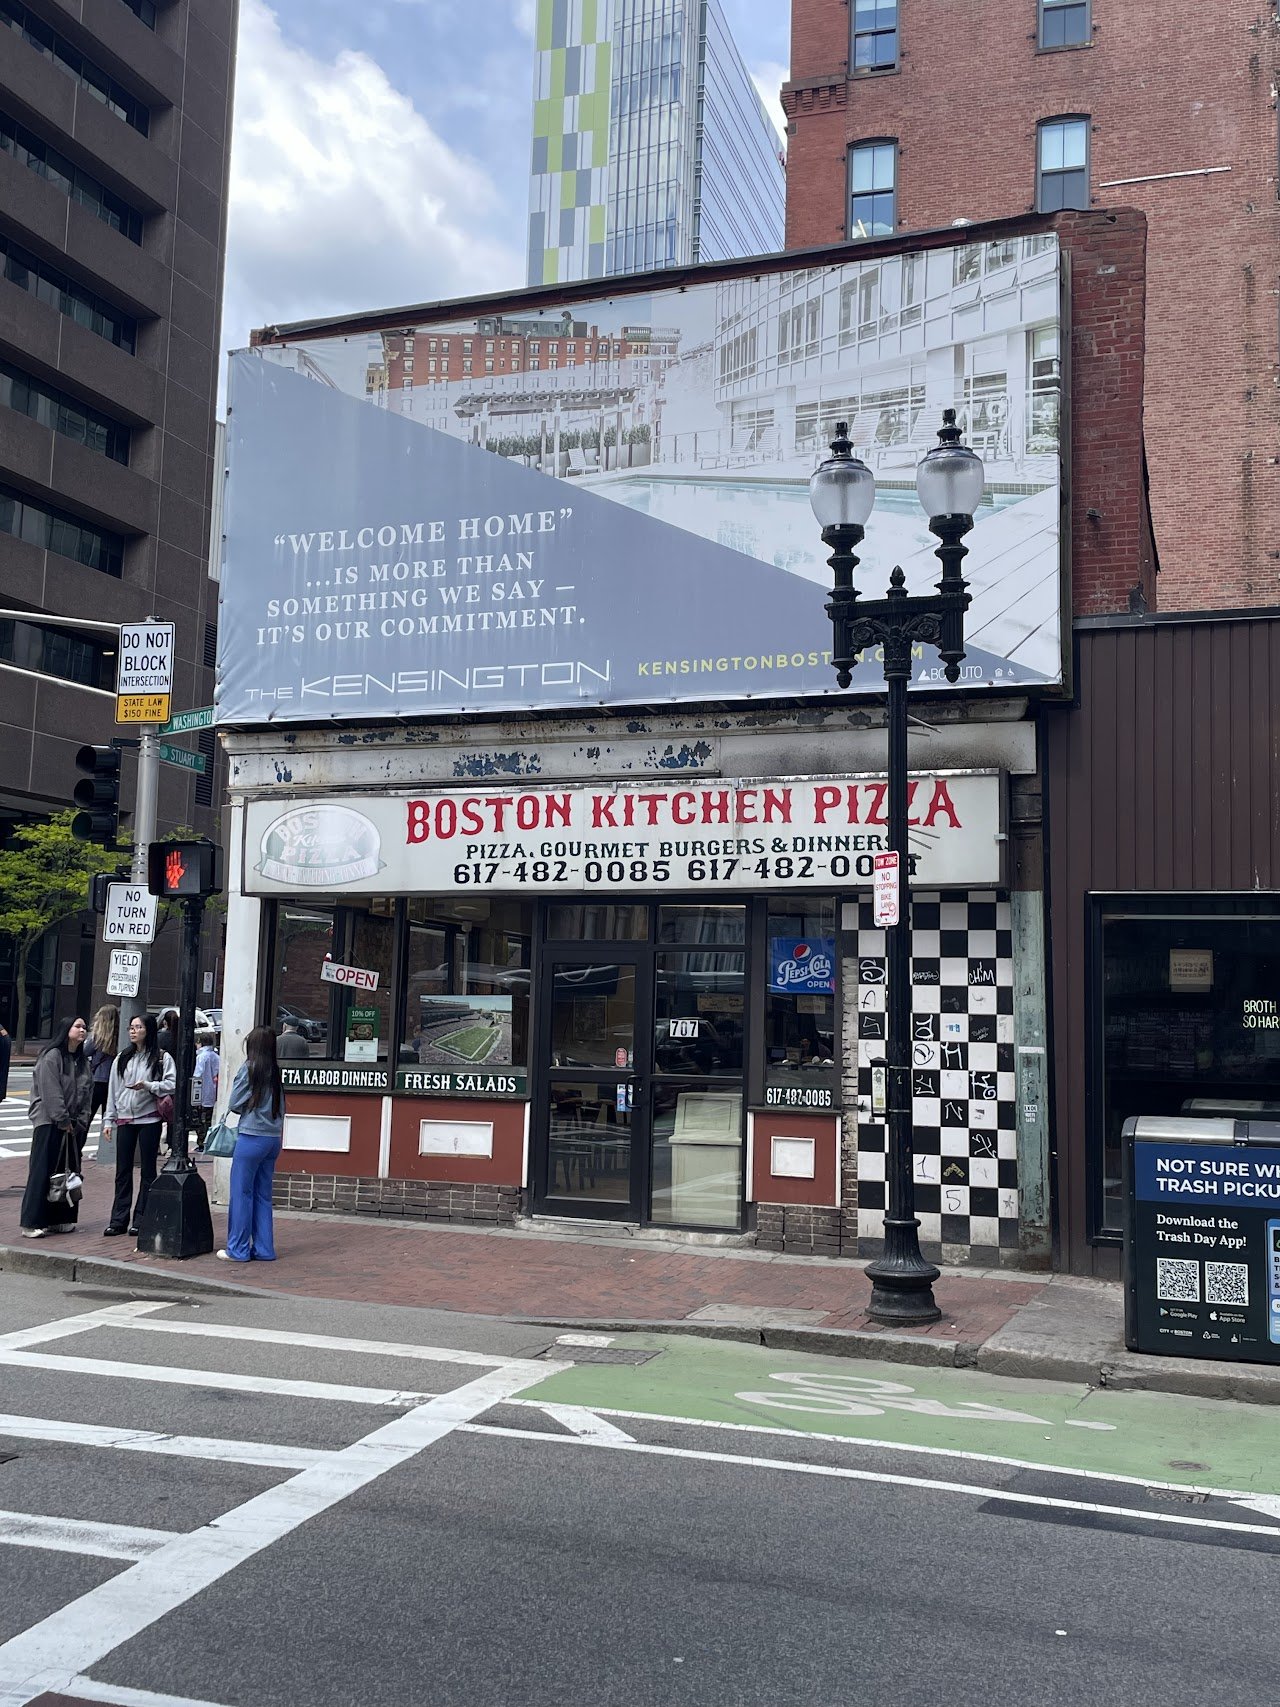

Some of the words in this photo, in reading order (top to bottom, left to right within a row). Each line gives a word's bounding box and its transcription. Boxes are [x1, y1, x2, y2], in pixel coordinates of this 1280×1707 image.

[369, 559, 447, 582] MORE
[457, 551, 534, 575] THAN
[267, 591, 428, 617] SOMETHING
[438, 584, 480, 604] WE
[491, 579, 545, 601] SAY
[256, 623, 306, 646] IT’S
[315, 618, 371, 641] OUR
[380, 605, 586, 638] COMMITMENT.
[122, 633, 140, 648] DO
[146, 632, 171, 648] NOT
[125, 655, 167, 671] BLOCK
[638, 645, 924, 677] KENSINGTONBOSTN.CM
[121, 675, 169, 687] INTERSECTION
[245, 686, 293, 700] THE
[301, 659, 610, 697] KENSINGTON
[931, 665, 983, 681] BOUTO
[124, 698, 144, 707] STATE
[148, 698, 163, 707] LAW
[124, 709, 142, 718] $150
[145, 708, 162, 717] FINE
[172, 710, 214, 730] WASHINGTO
[170, 749, 196, 767] STUART
[406, 793, 572, 845] BOSTON
[591, 788, 793, 828] KITCHEN
[541, 841, 649, 858] GOURMET
[660, 838, 765, 857] BURGERS
[793, 834, 890, 853] DINNER
[454, 859, 670, 885] 617-482-0085
[881, 872, 890, 881] NO
[876, 882, 897, 890] STOPPING
[125, 891, 141, 902] NO
[118, 906, 147, 919] TURN
[109, 923, 125, 934] ON
[128, 923, 151, 935] RED
[114, 954, 138, 966] YIELD
[335, 967, 376, 988] OPEN
[118, 983, 135, 993] TURNS
[351, 1010, 364, 1018] 10%
[364, 1010, 375, 1018] OFF
[1257, 1015, 1280, 1029] HAR
[671, 1021, 697, 1037] 707
[304, 1069, 340, 1086] KABOB
[341, 1070, 388, 1087] DINNERS
[404, 1073, 450, 1090] FRESH
[455, 1075, 517, 1093] SALADS
[766, 1087, 831, 1106] 617-482-0085
[1156, 1158, 1196, 1174] NOT
[1200, 1160, 1250, 1177] SURE
[1156, 1177, 1218, 1195] TRASH
[1157, 1213, 1215, 1228] Download
[1218, 1216, 1239, 1230] the
[1156, 1230, 1191, 1244] Trash
[1194, 1234, 1217, 1248] Day
[1219, 1235, 1248, 1249] App!
[1170, 1311, 1187, 1319] Google
